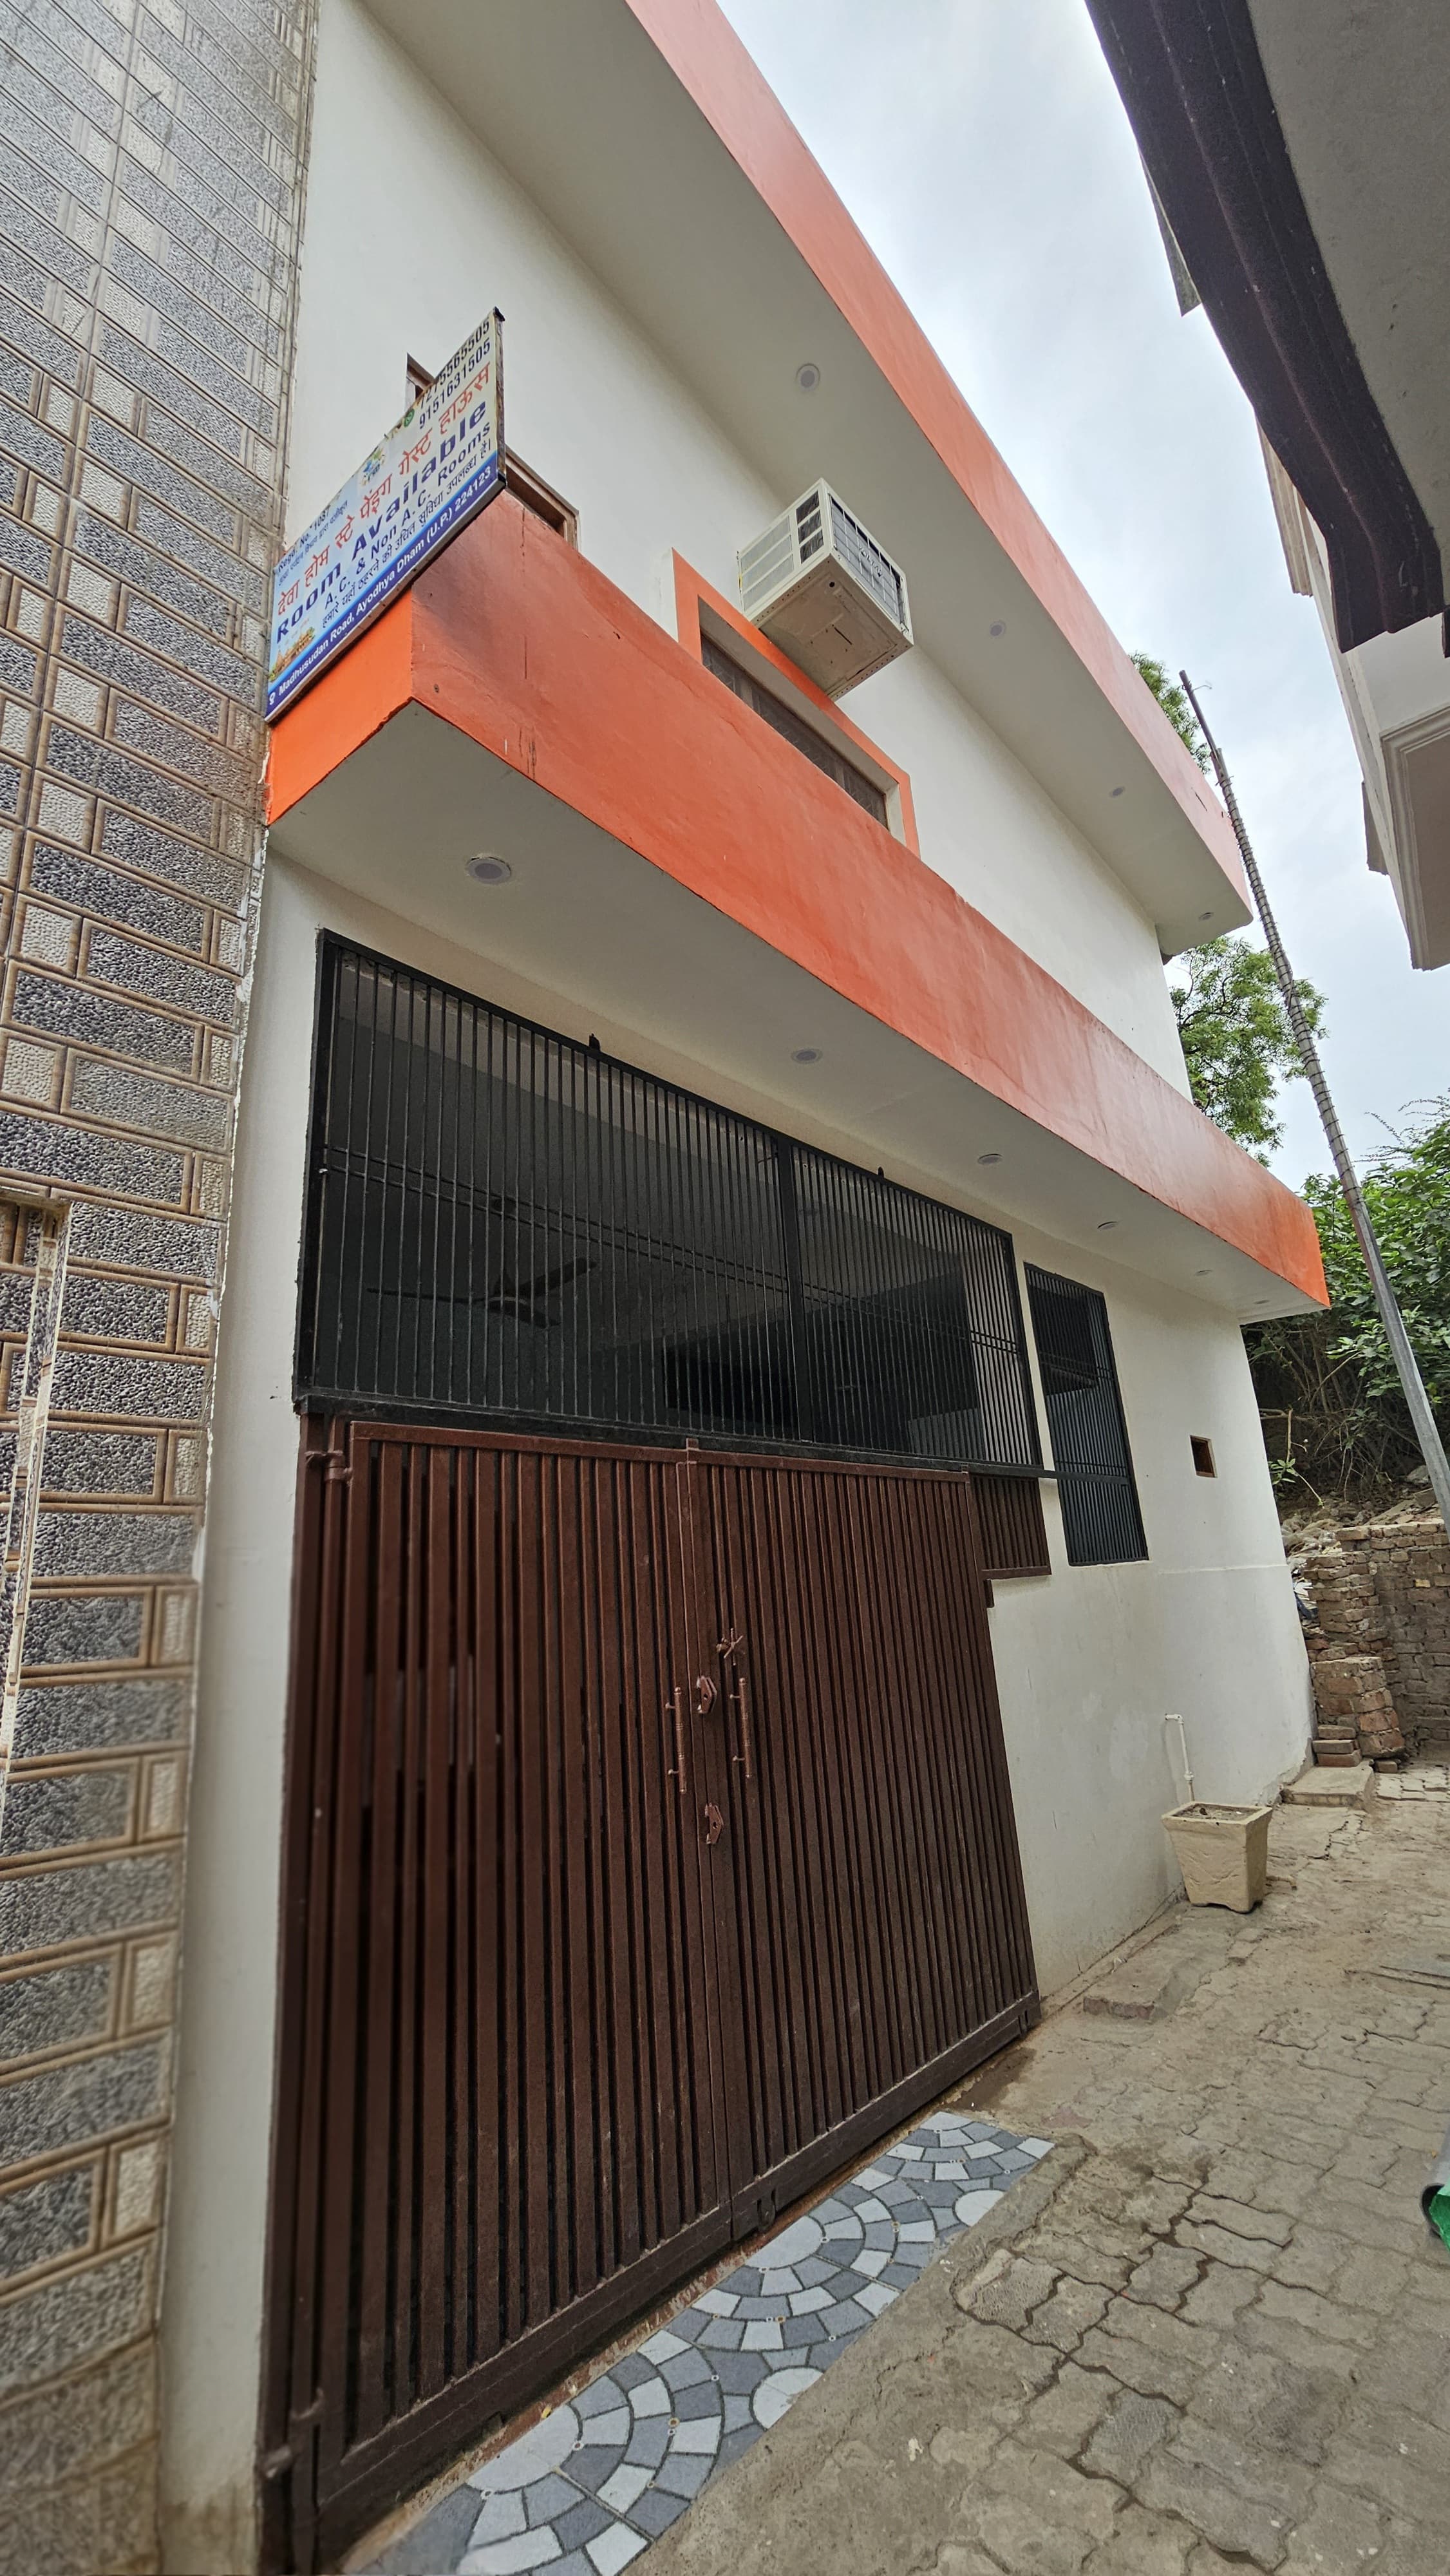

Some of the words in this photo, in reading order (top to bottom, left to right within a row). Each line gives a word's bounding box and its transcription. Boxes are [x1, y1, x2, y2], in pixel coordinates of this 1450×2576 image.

[419, 337, 490, 430] 9151631505
[277, 562, 341, 643] Room
[352, 401, 486, 561] Available
[278, 579, 299, 616] देवा
[305, 544, 330, 587] होम
[335, 515, 354, 548] स्टे
[398, 428, 433, 475] गेस्ट
[438, 361, 490, 435] हाऊस
[278, 639, 328, 696] Madhusudan
[330, 612, 354, 642] Road,
[356, 571, 395, 615] Ayodhya
[397, 539, 425, 573] Dham
[427, 507, 452, 544] (U.P.)
[455, 466, 491, 511] 224123
[323, 601, 339, 628] हमारे
[358, 558, 379, 590] ठहरने
[382, 544, 392, 563] की
[395, 521, 415, 551] उचित
[419, 491, 443, 527] सुविधा
[446, 454, 476, 495] उपलब्ध
[356, 557, 366, 574] &
[371, 525, 397, 560] Non
[438, 422, 490, 487] Rooms
